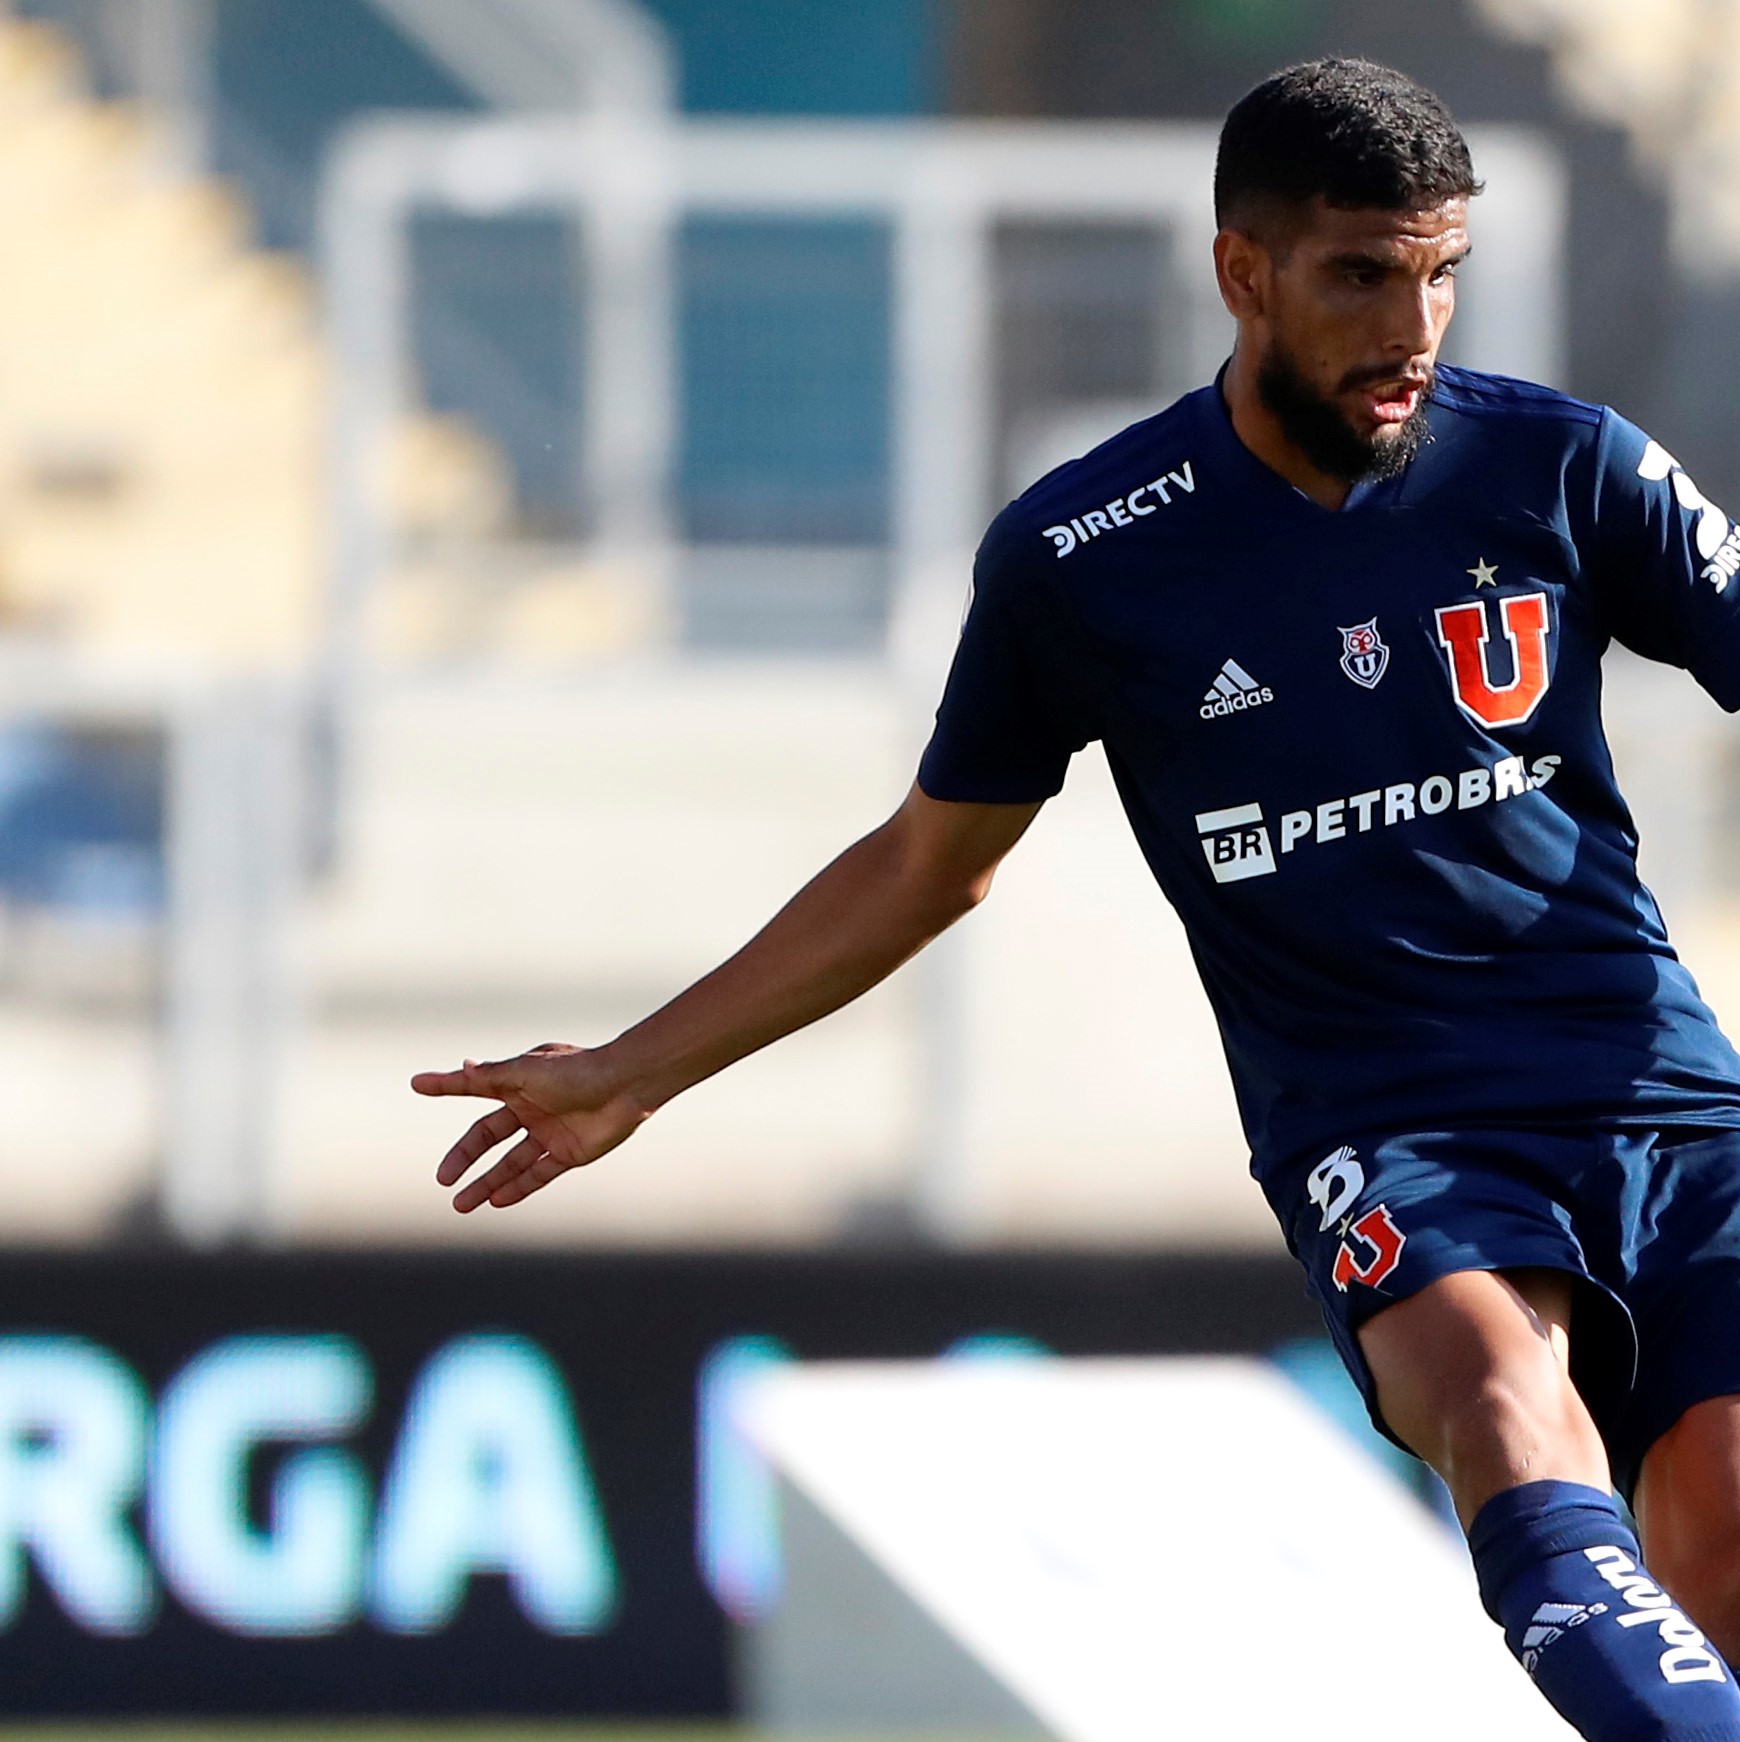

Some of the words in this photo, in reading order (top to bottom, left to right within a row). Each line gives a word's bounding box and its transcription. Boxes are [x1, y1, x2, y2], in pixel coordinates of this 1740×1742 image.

[1042, 460, 1195, 558] DIRECTV
[1199, 687, 1274, 719] adidas
[1353, 652, 1376, 678] U
[1434, 592, 1550, 729] U
[0, 1333, 617, 1637] RGA
[1529, 1602, 1609, 1681] didas
